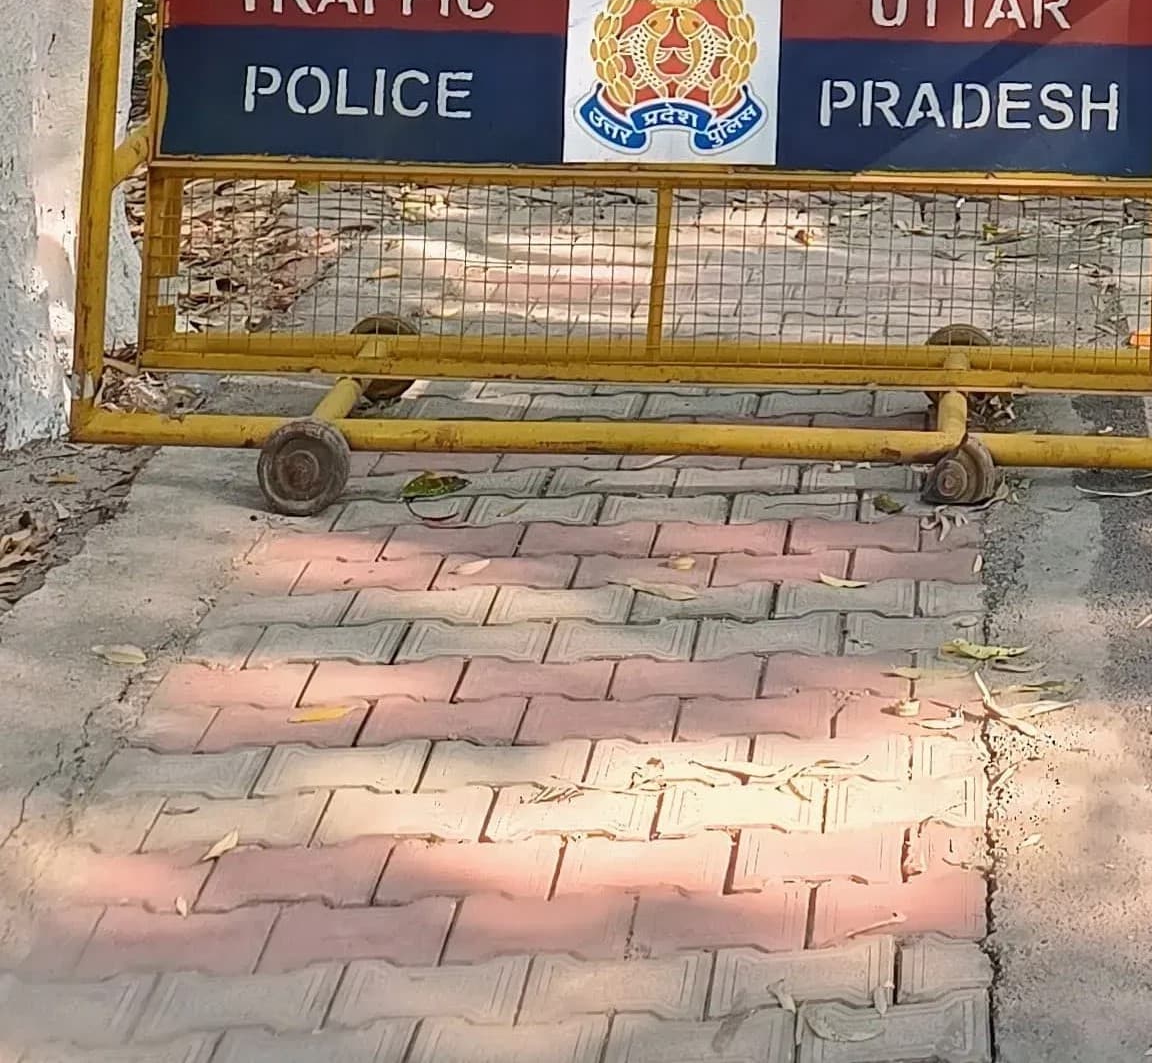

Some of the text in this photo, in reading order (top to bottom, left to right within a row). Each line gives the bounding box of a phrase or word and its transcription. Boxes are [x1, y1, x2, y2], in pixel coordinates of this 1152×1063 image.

[244, 65, 473, 118] POLICE
[820, 79, 1119, 131] PRADESH
[589, 103, 757, 148] उत्तर प्रदेश पुलिस
